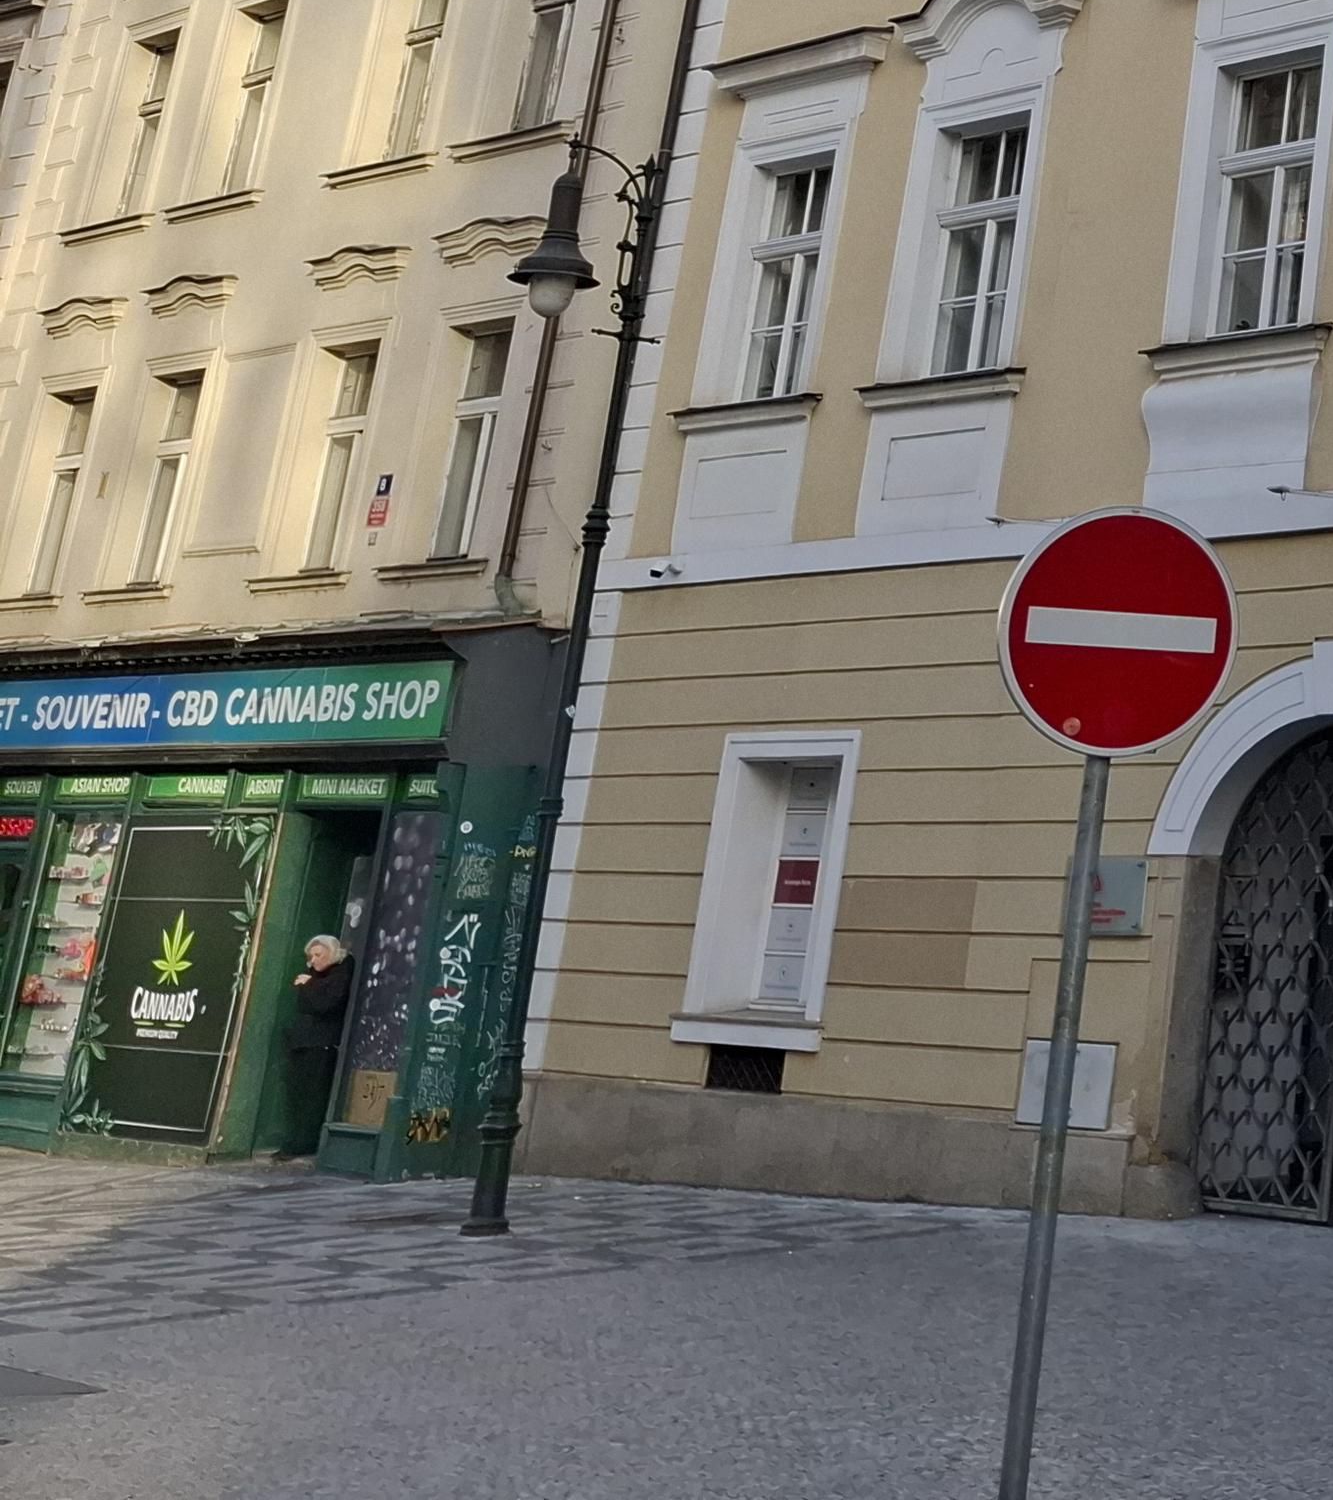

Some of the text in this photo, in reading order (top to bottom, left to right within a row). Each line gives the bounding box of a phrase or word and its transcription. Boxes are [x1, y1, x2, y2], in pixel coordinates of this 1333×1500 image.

[0, 697, 20, 731] T
[32, 692, 151, 731] SOUVENIR
[167, 690, 219, 728] CBD
[225, 683, 360, 726] CANNABIS
[362, 679, 441, 721] SHOP
[71, 777, 131, 794] ASIAN SHOP
[311, 778, 387, 795] MINI MARKET
[131, 986, 198, 1022] CANNABIS
